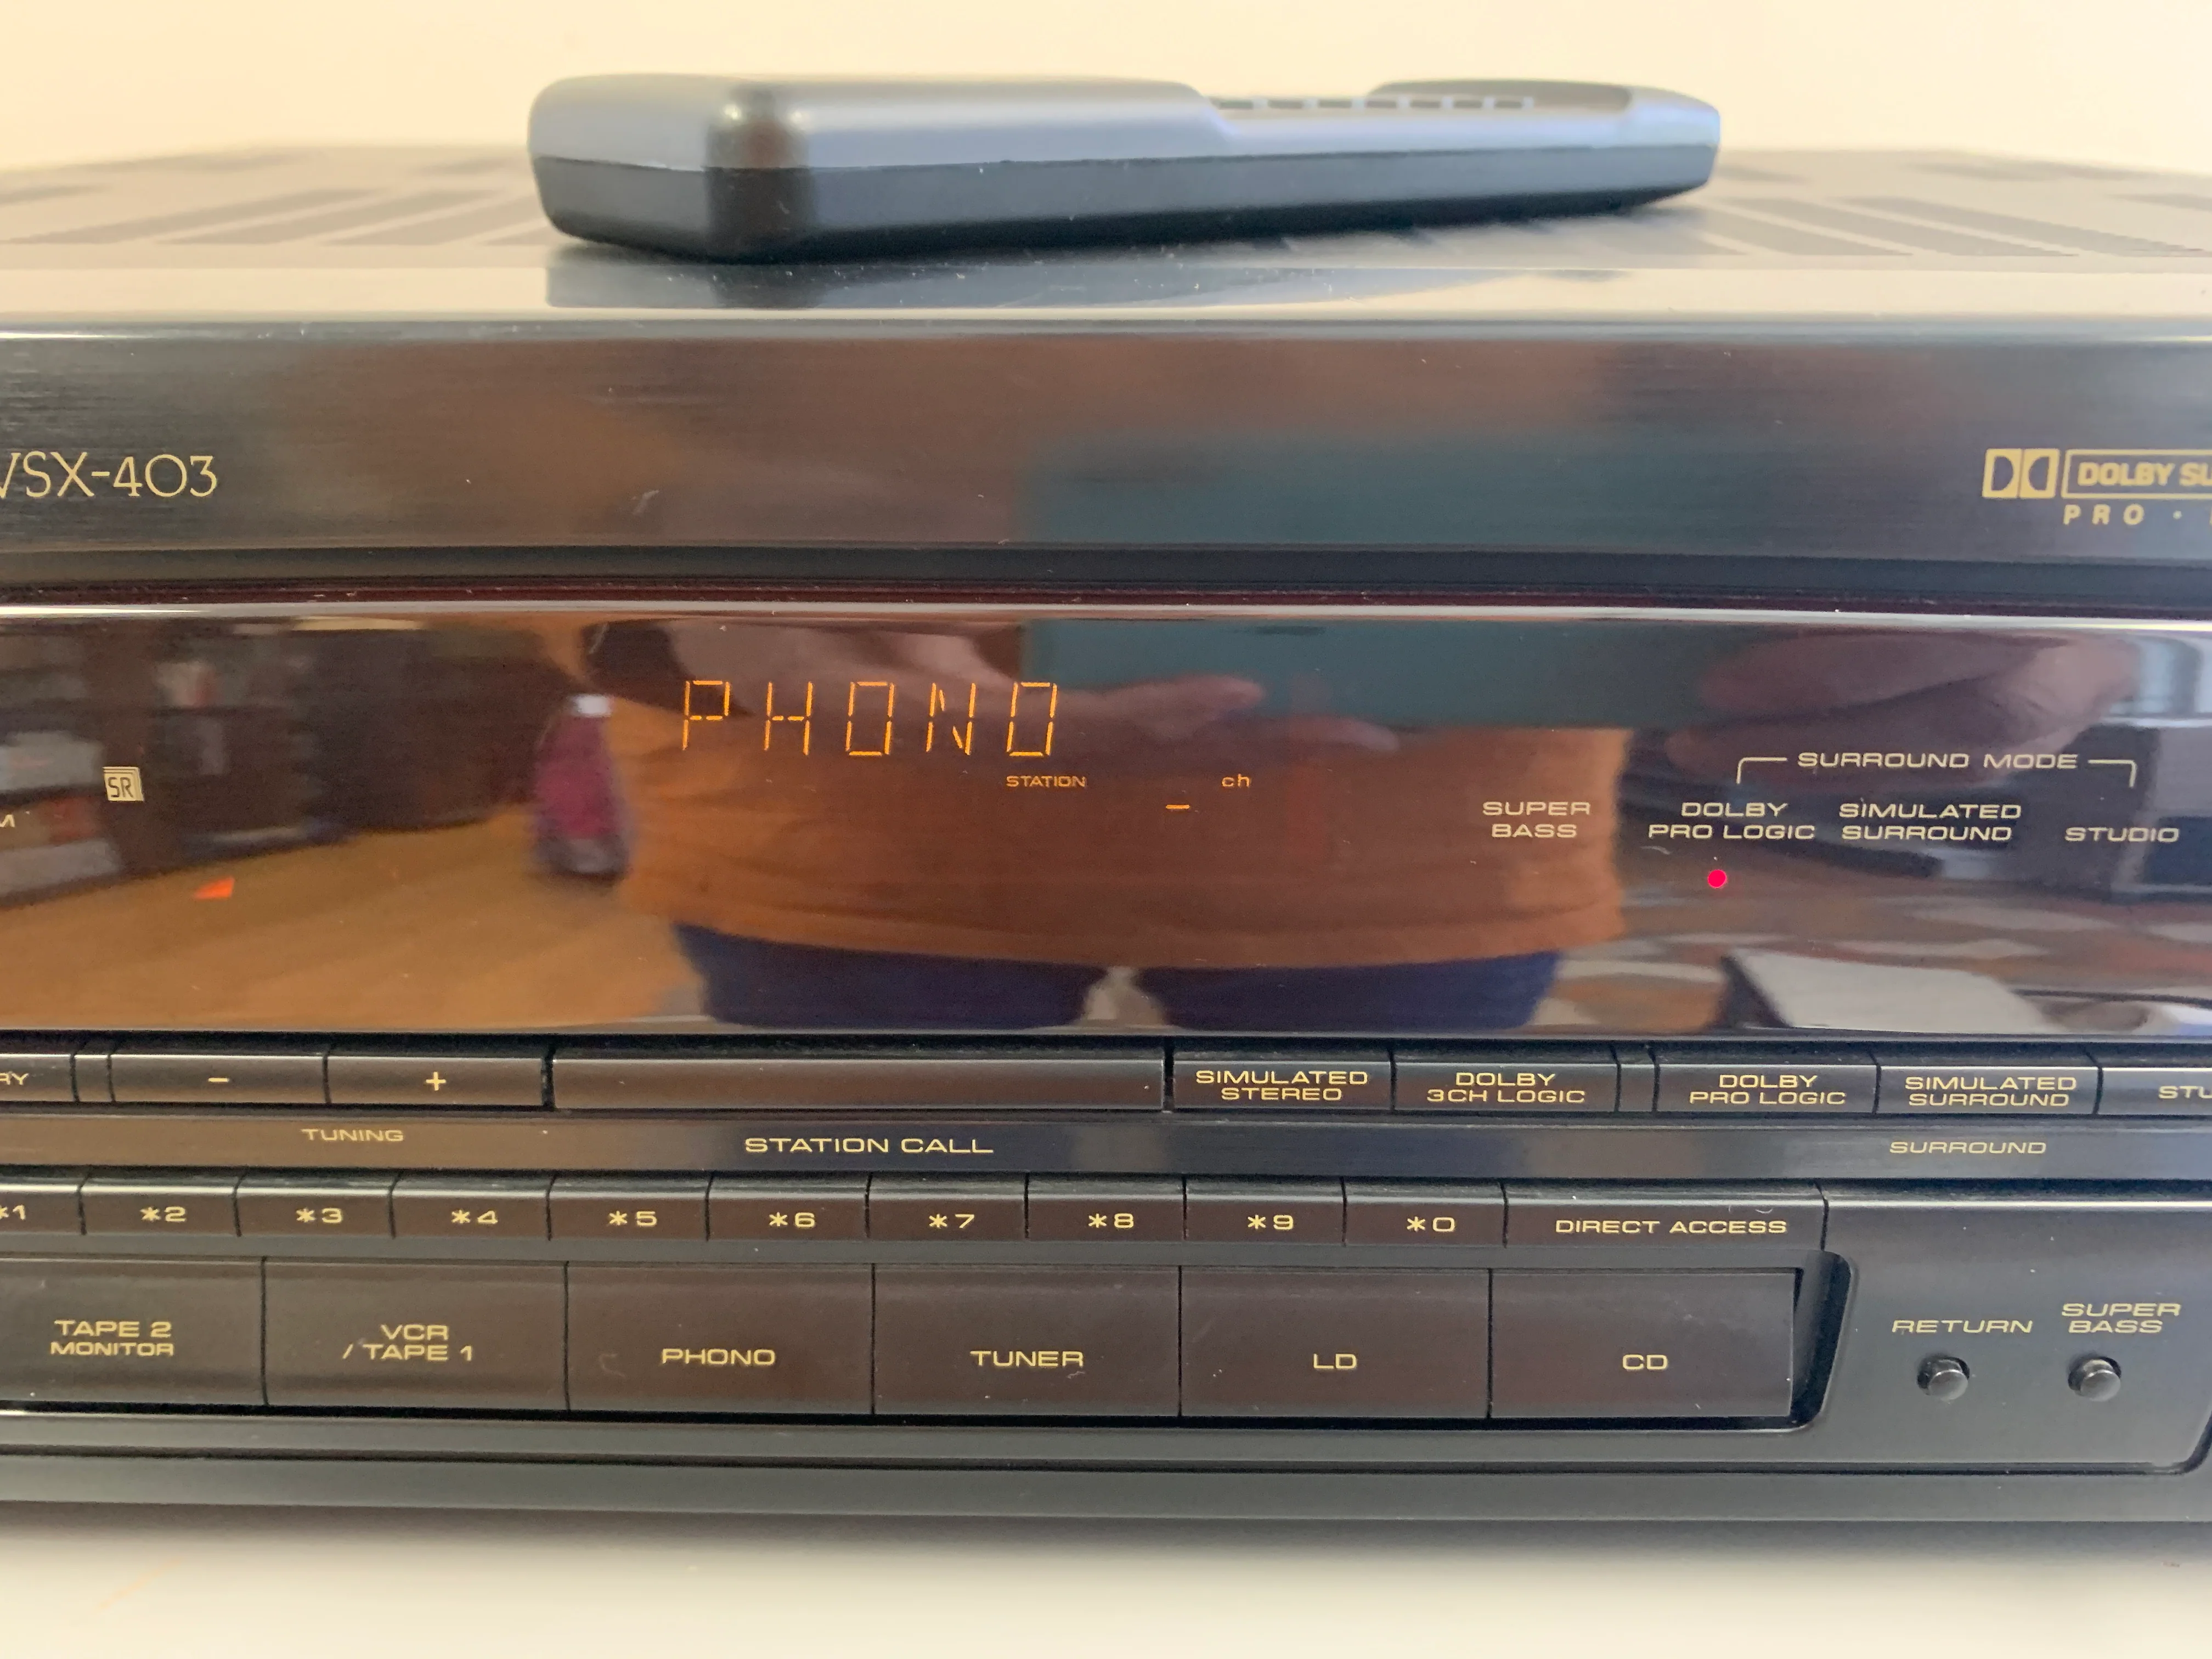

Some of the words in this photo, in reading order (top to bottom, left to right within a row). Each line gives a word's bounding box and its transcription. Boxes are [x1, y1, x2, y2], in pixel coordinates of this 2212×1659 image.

[2077, 462, 2174, 486] DOLBY
[2063, 503, 2144, 525] PRO
[681, 680, 1058, 757] PHONO
[1797, 752, 1970, 768] SURROUND
[1983, 753, 2078, 769] MODE
[108, 776, 133, 798] SR
[1006, 775, 1085, 787] STATION
[1221, 774, 1250, 787] ch
[1482, 801, 1592, 816] SUPER
[1681, 802, 1787, 817] DOLBY
[1839, 803, 2022, 819] SIMULATED
[1491, 823, 1578, 838] BASS
[1648, 824, 1713, 839] PRO
[1723, 825, 1815, 839] LOGIC
[1842, 825, 2012, 841] SURROUND
[2064, 827, 2179, 842] STUDIO
[1196, 1070, 1368, 1085] SIMULATED
[1455, 1072, 1555, 1086] DOLBY
[1719, 1074, 1818, 1088] DOLBY
[1905, 1076, 2076, 1090] SIMULATED
[1221, 1087, 1342, 1101] STEREO
[1427, 1089, 1488, 1102] 3CH
[1497, 1090, 1585, 1103] LOGIC
[1689, 1091, 1750, 1104] PRO
[1759, 1091, 1846, 1105] LOGIC
[1909, 1093, 2069, 1107] SURROUND
[301, 1128, 404, 1142] TUNING
[745, 1138, 889, 1153] STATION
[901, 1138, 994, 1153] CALL
[1889, 1141, 2046, 1154] SURROUND
[1555, 1220, 1660, 1234] DIRECT
[1669, 1220, 1787, 1234] ACCESS
[2062, 1303, 2181, 1317] SUPER
[54, 1320, 140, 1338] TAPE
[150, 1321, 172, 1338] 2
[381, 1324, 448, 1341] VCR
[1892, 1320, 2033, 1333] RETURN
[2068, 1319, 2163, 1333] BASS
[50, 1341, 174, 1356] MONITOR
[460, 1345, 472, 1361] 1
[662, 1348, 775, 1365] PHONO
[969, 1351, 1084, 1367] TUNER
[1313, 1353, 1357, 1370] LD
[1622, 1354, 1668, 1370] CD
